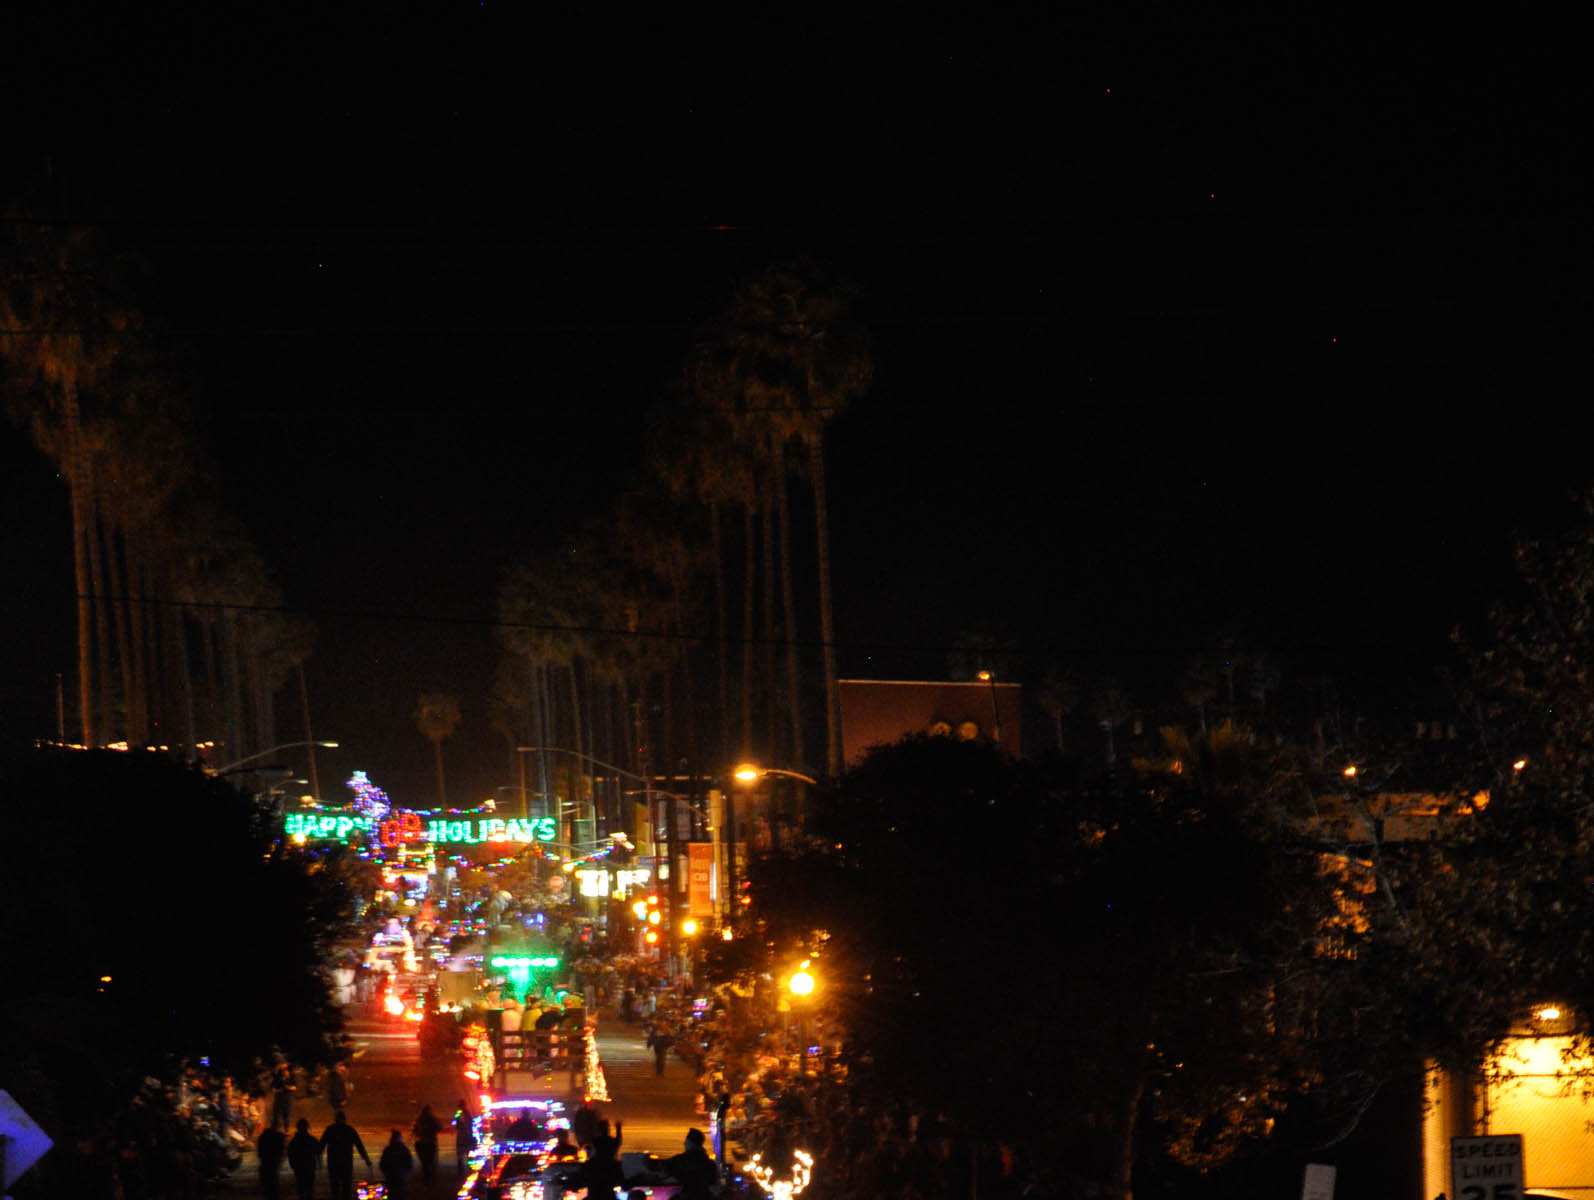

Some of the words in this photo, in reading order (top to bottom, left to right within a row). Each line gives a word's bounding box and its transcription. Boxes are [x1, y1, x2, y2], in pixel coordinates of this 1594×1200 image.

[285, 814, 373, 837] HAPPY
[428, 817, 556, 843] HOLIDAYS
[1456, 1142, 1519, 1158] SPEED
[1463, 1163, 1513, 1178] LIMIT
